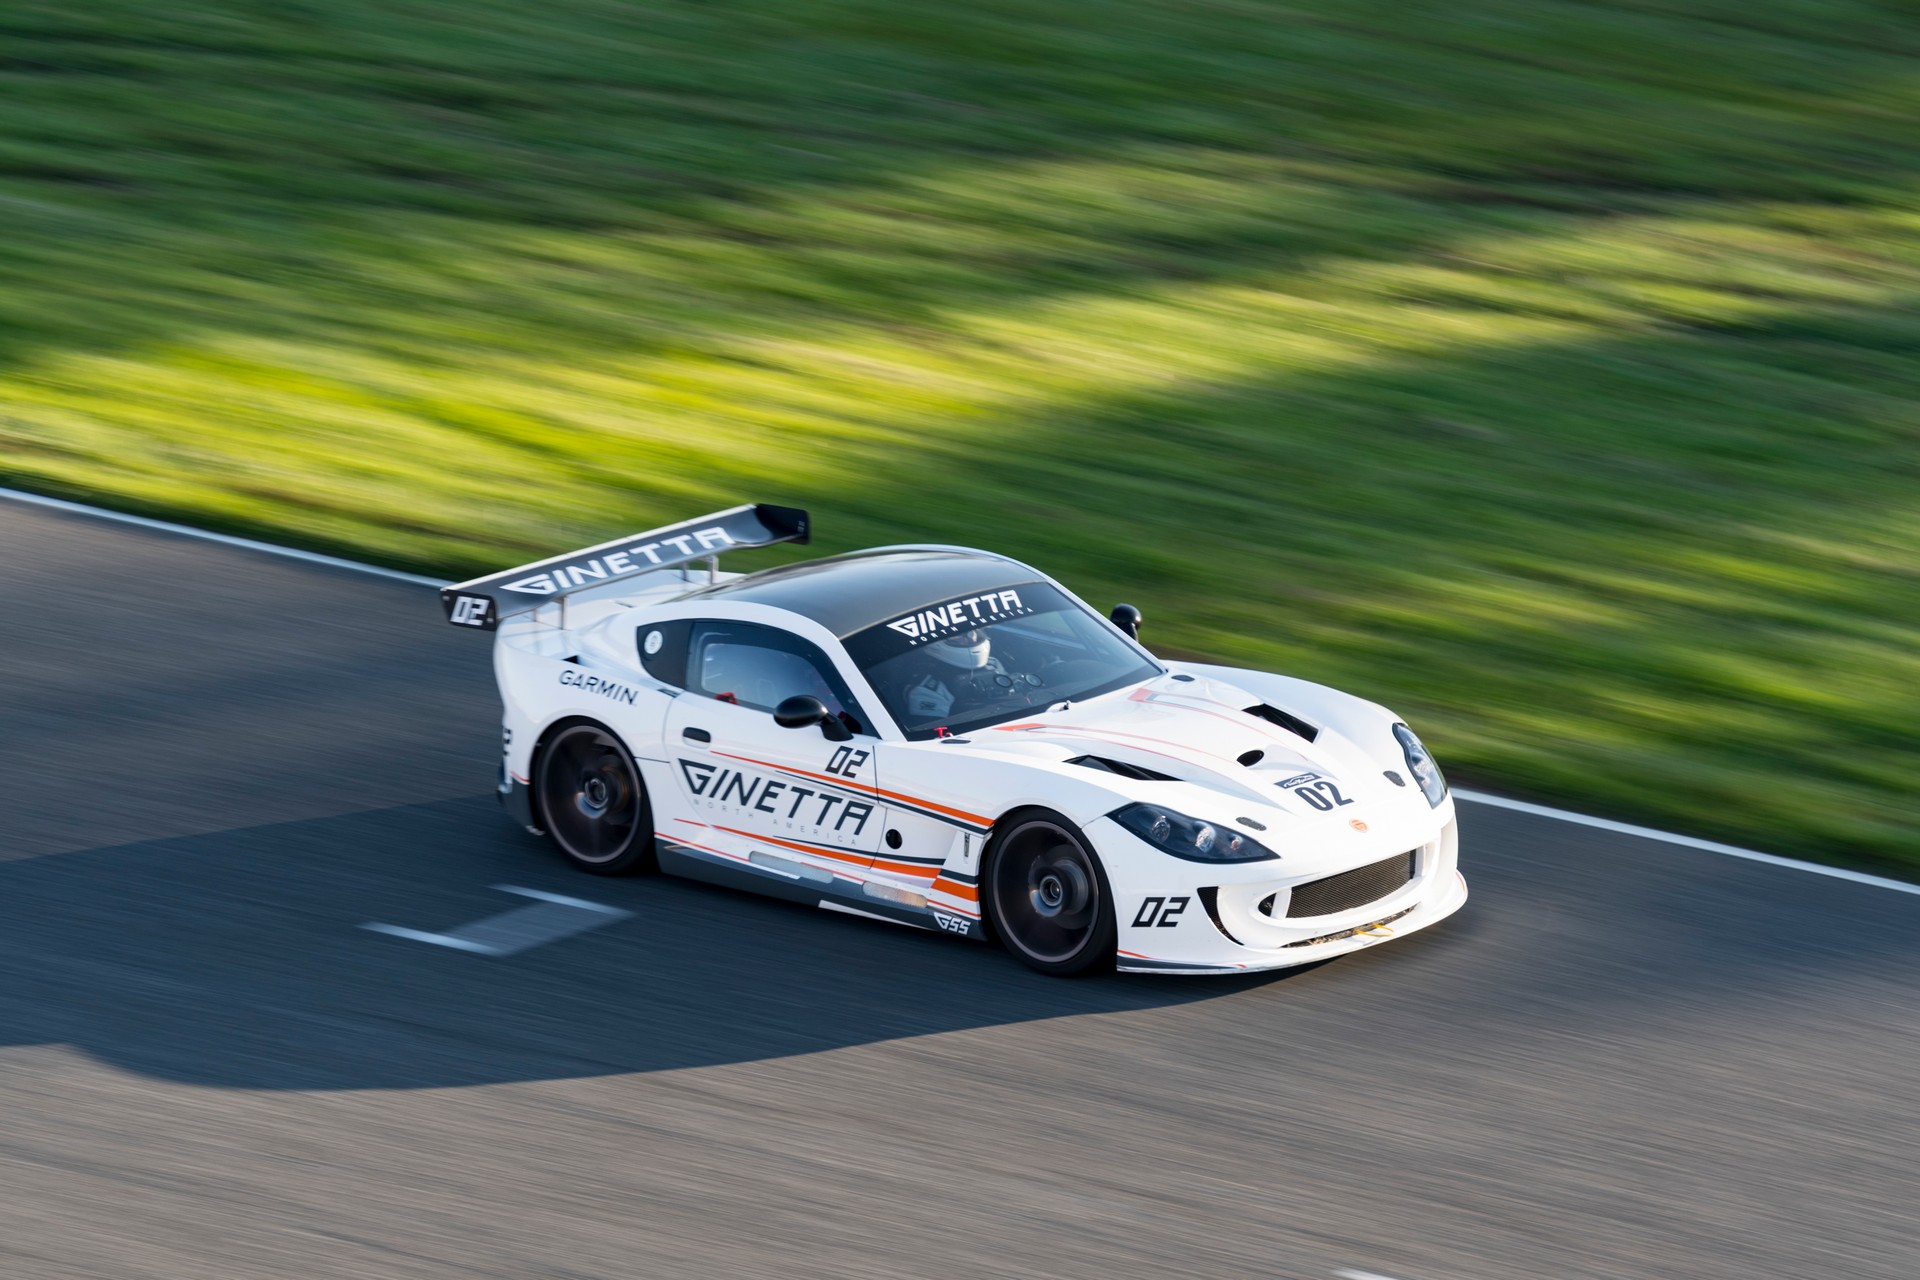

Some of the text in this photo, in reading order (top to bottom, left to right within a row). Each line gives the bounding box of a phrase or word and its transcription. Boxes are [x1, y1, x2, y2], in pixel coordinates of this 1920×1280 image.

[500, 526, 736, 595] GINETTA
[450, 595, 490, 626] 02
[887, 589, 1022, 638] GINETTA
[909, 607, 1034, 646] NORTH AMERICA
[559, 669, 639, 706] GARMIN
[825, 745, 870, 779] 02
[678, 757, 874, 836] GINETTA
[1294, 780, 1355, 811] 02
[693, 798, 857, 847] NORTH AMERICA
[933, 911, 971, 936] GSS
[1131, 896, 1191, 928] 02
